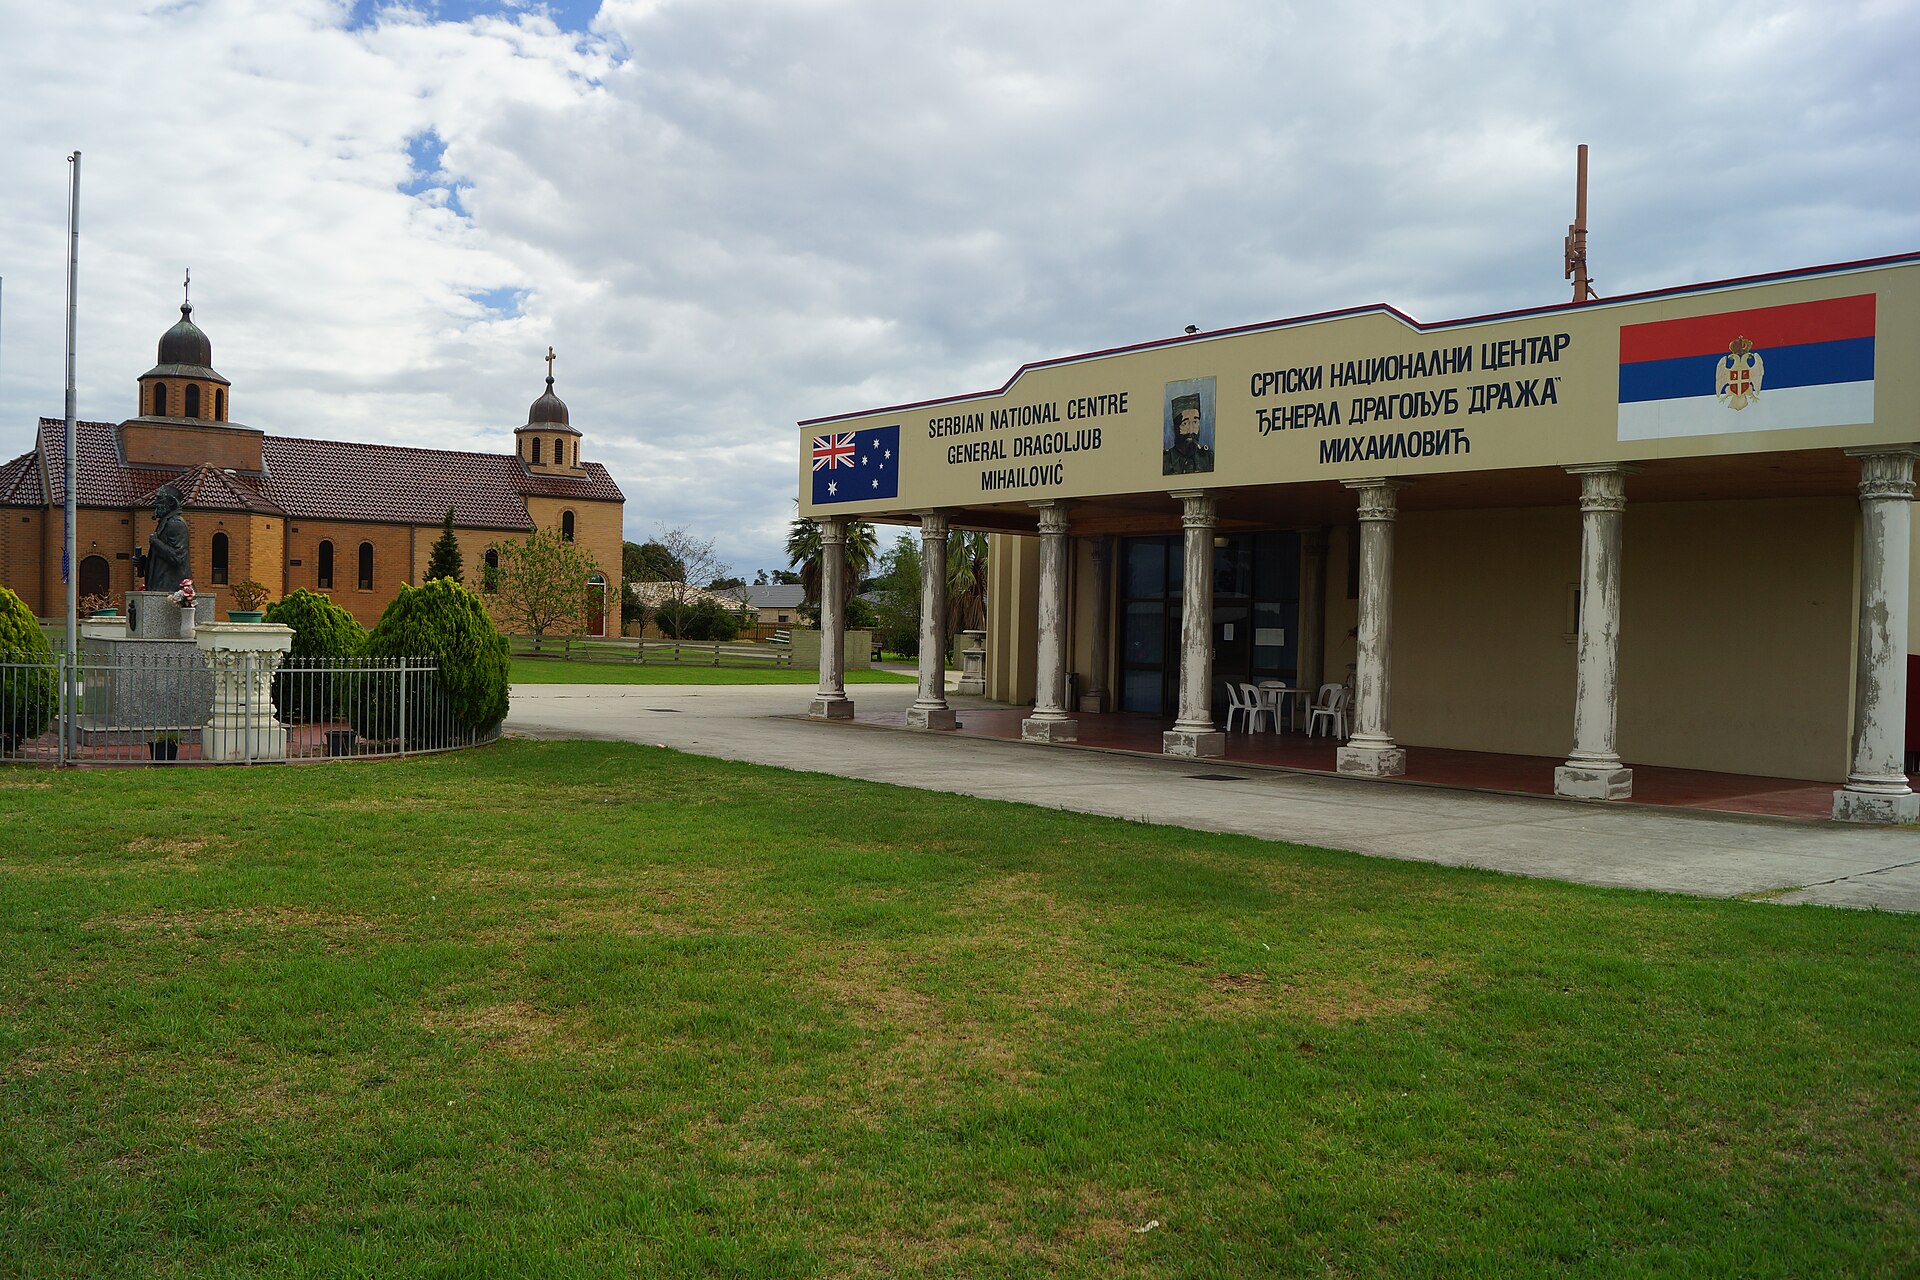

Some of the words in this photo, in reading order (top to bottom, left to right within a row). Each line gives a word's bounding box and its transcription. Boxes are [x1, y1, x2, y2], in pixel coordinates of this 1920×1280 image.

[1250, 365, 1323, 398] СРПСКИ
[1330, 345, 1473, 389] НАЦИОНАЛНИ
[1480, 332, 1571, 372] ЦЕНТАР
[929, 410, 984, 438] SERBIAN
[990, 401, 1060, 430] NATIONAL
[1067, 391, 1129, 420] CENTRE
[1255, 400, 1341, 437] ЂЕНЕРАЛ
[1348, 387, 1459, 426] ДРАГОЉУБ
[947, 439, 1008, 465] GENERAL
[1013, 427, 1102, 458] DRAGOLJUB
[1319, 427, 1471, 465] МИХАИЛОВИЋ
[981, 458, 1064, 491] MIHAILOVIĆ
